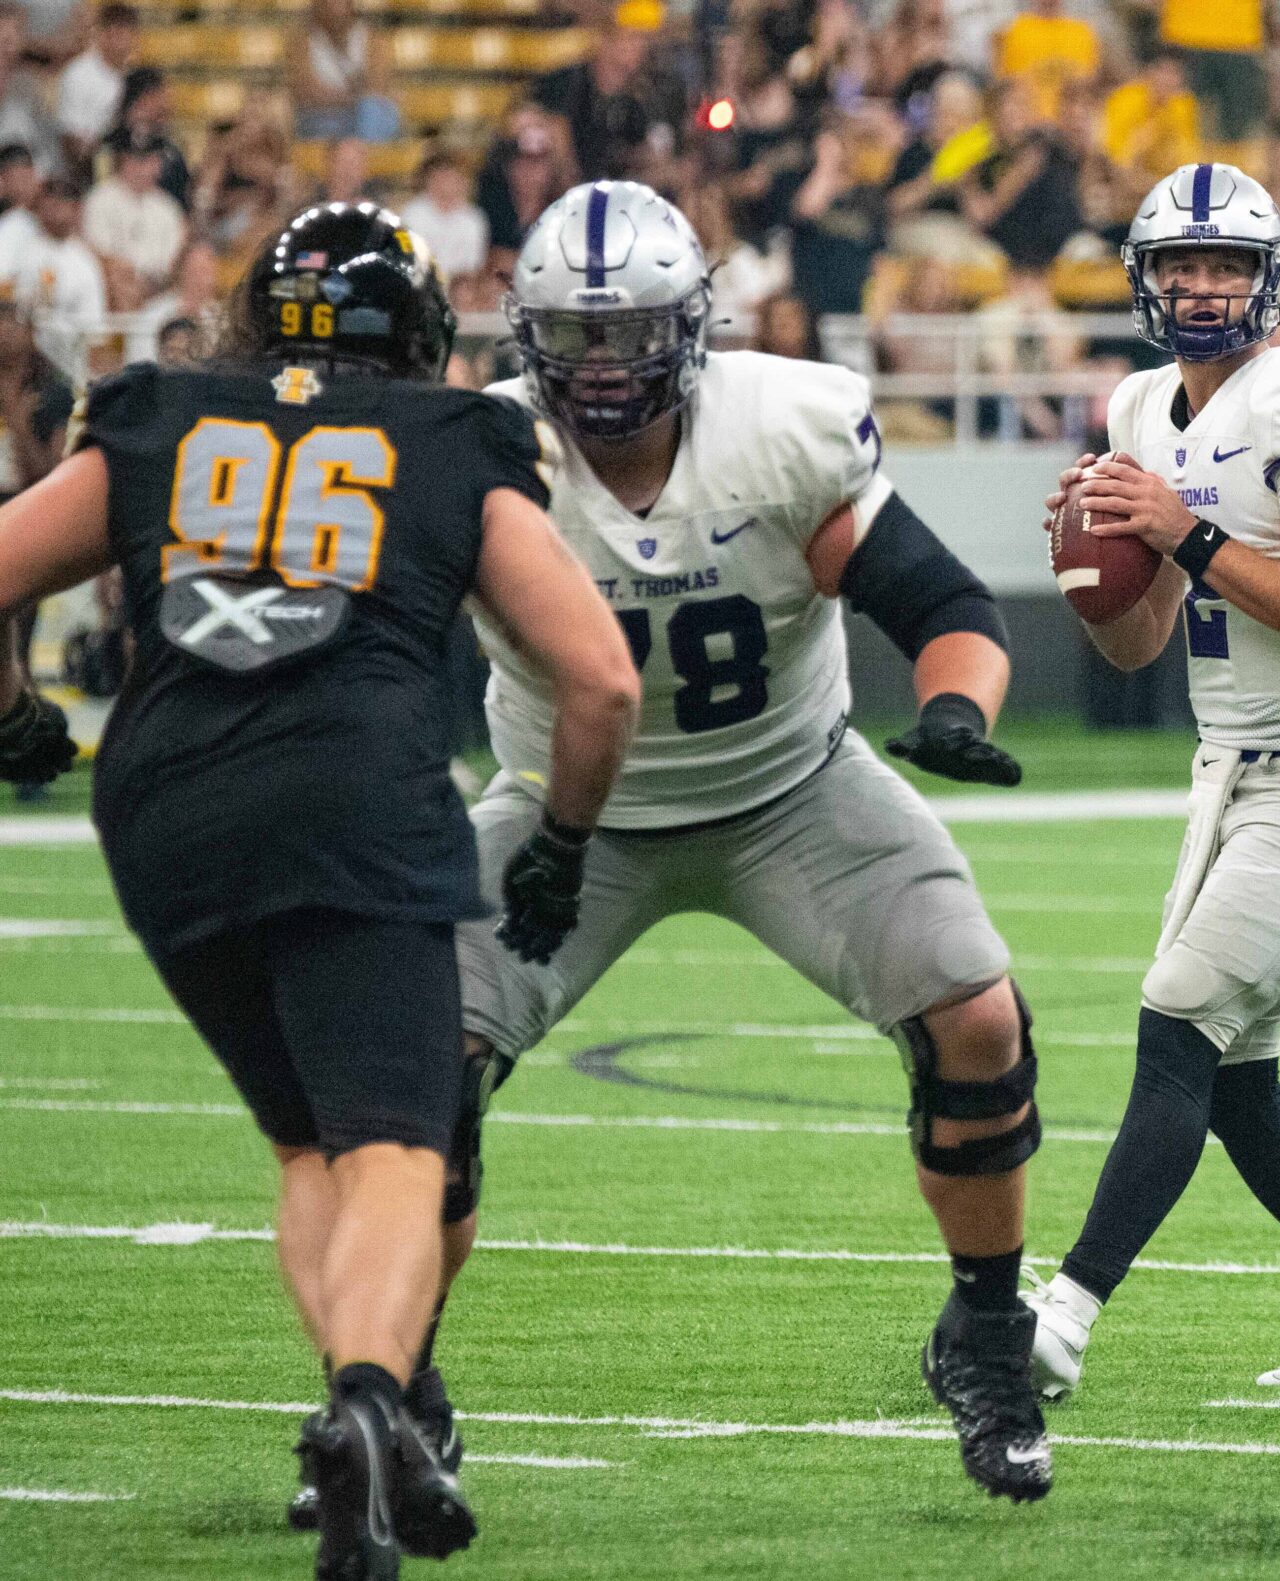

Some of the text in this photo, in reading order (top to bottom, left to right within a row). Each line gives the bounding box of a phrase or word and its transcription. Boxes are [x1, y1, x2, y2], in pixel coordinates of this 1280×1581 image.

[281, 302, 334, 337] 96
[160, 416, 399, 592] 96
[1053, 505, 1066, 555] Wilso
[596, 567, 719, 600] T. THOMAS
